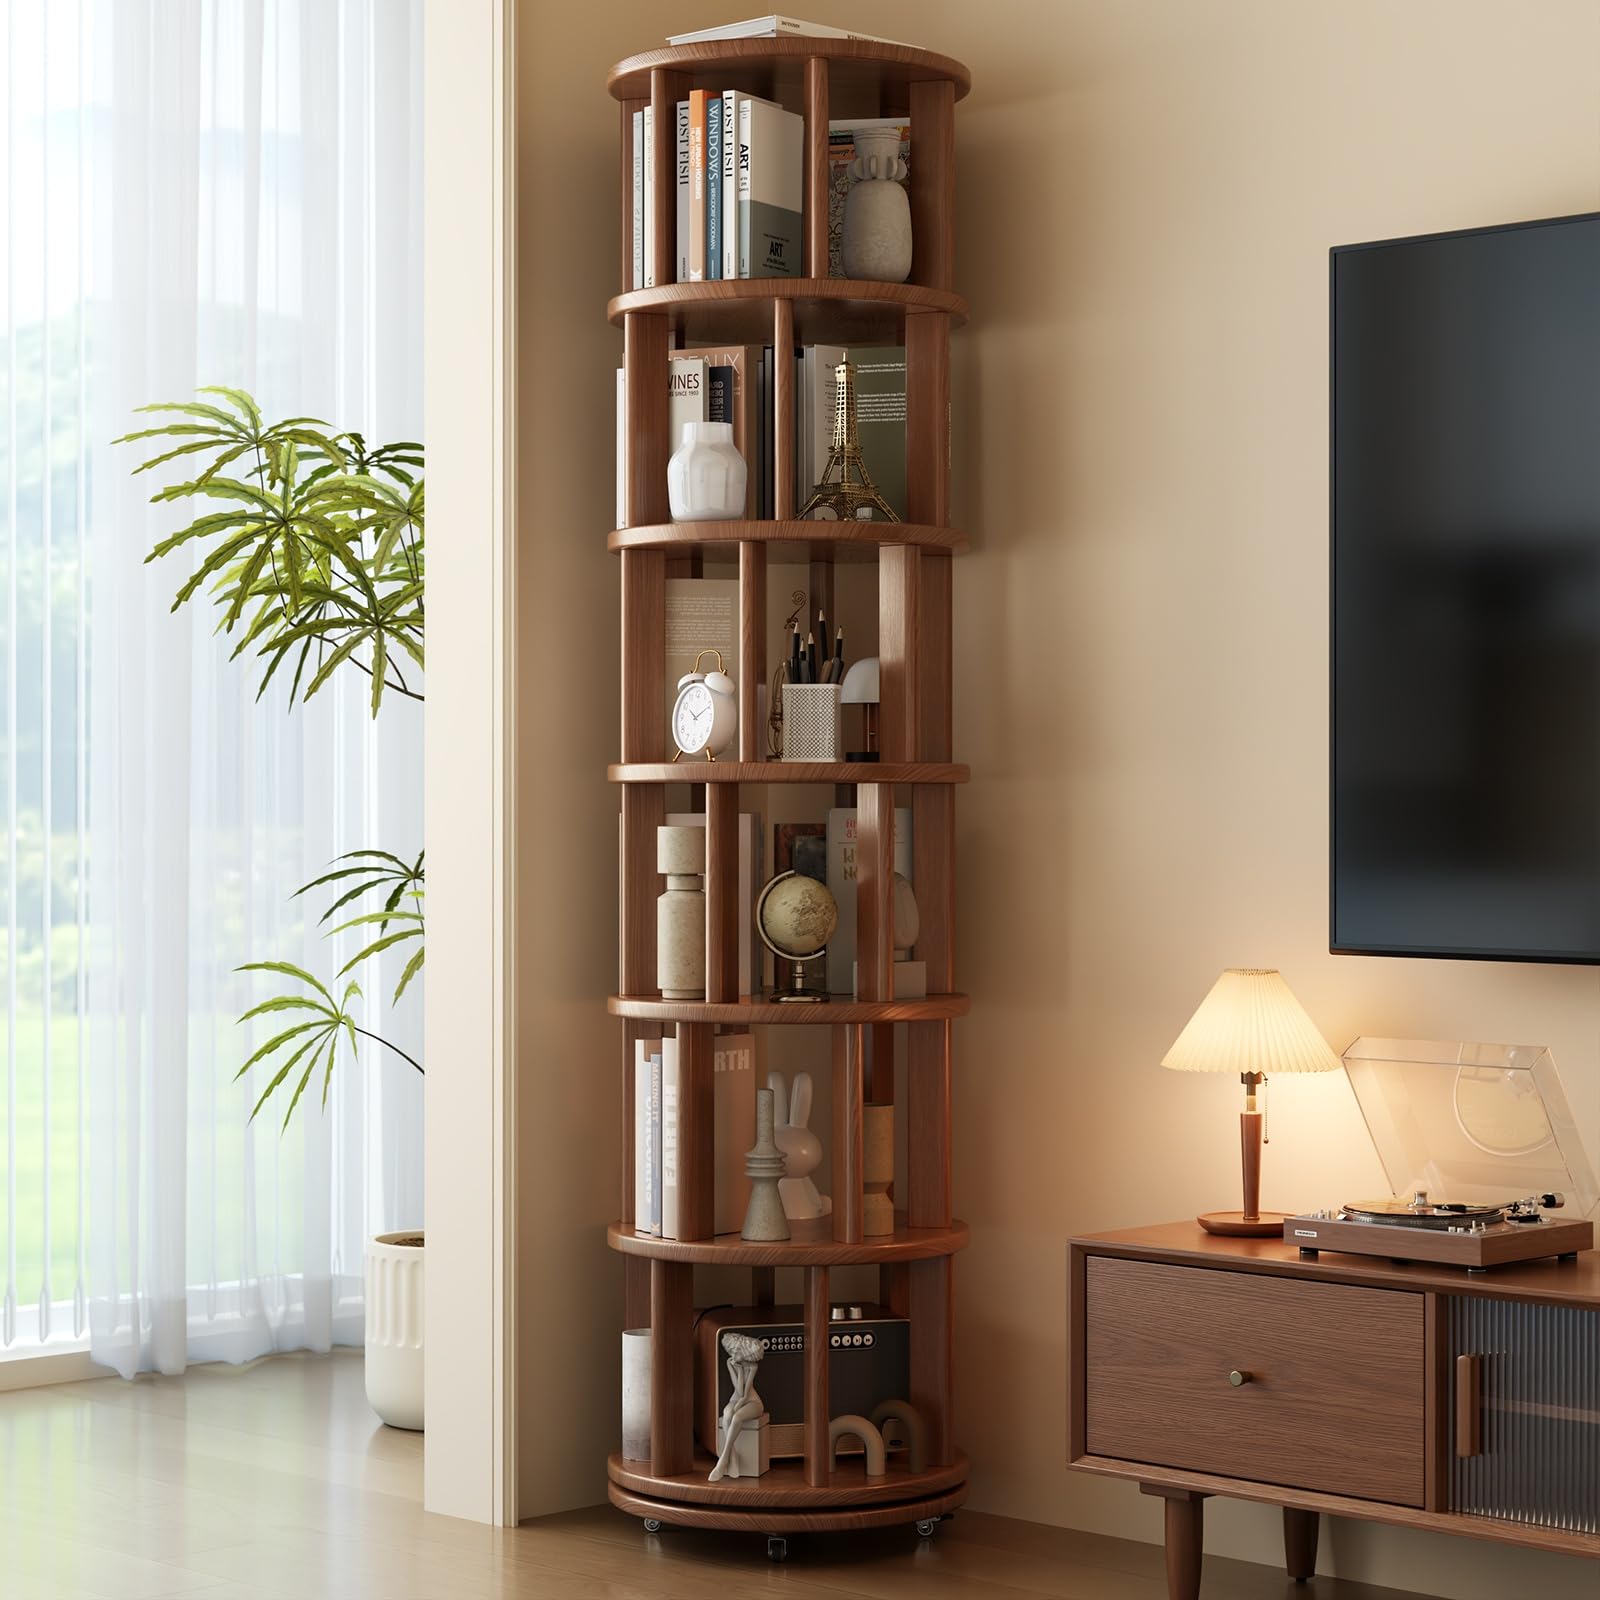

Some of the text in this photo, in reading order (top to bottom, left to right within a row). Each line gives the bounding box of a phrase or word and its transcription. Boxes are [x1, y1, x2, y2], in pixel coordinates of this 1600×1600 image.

[679, 105, 690, 185] LOST FISH
[708, 104, 719, 180] WINDOWS
[724, 96, 733, 178] LOST FISH
[739, 143, 749, 172] ART
[769, 240, 784, 257] ART
[652, 1111, 659, 1122] IT
